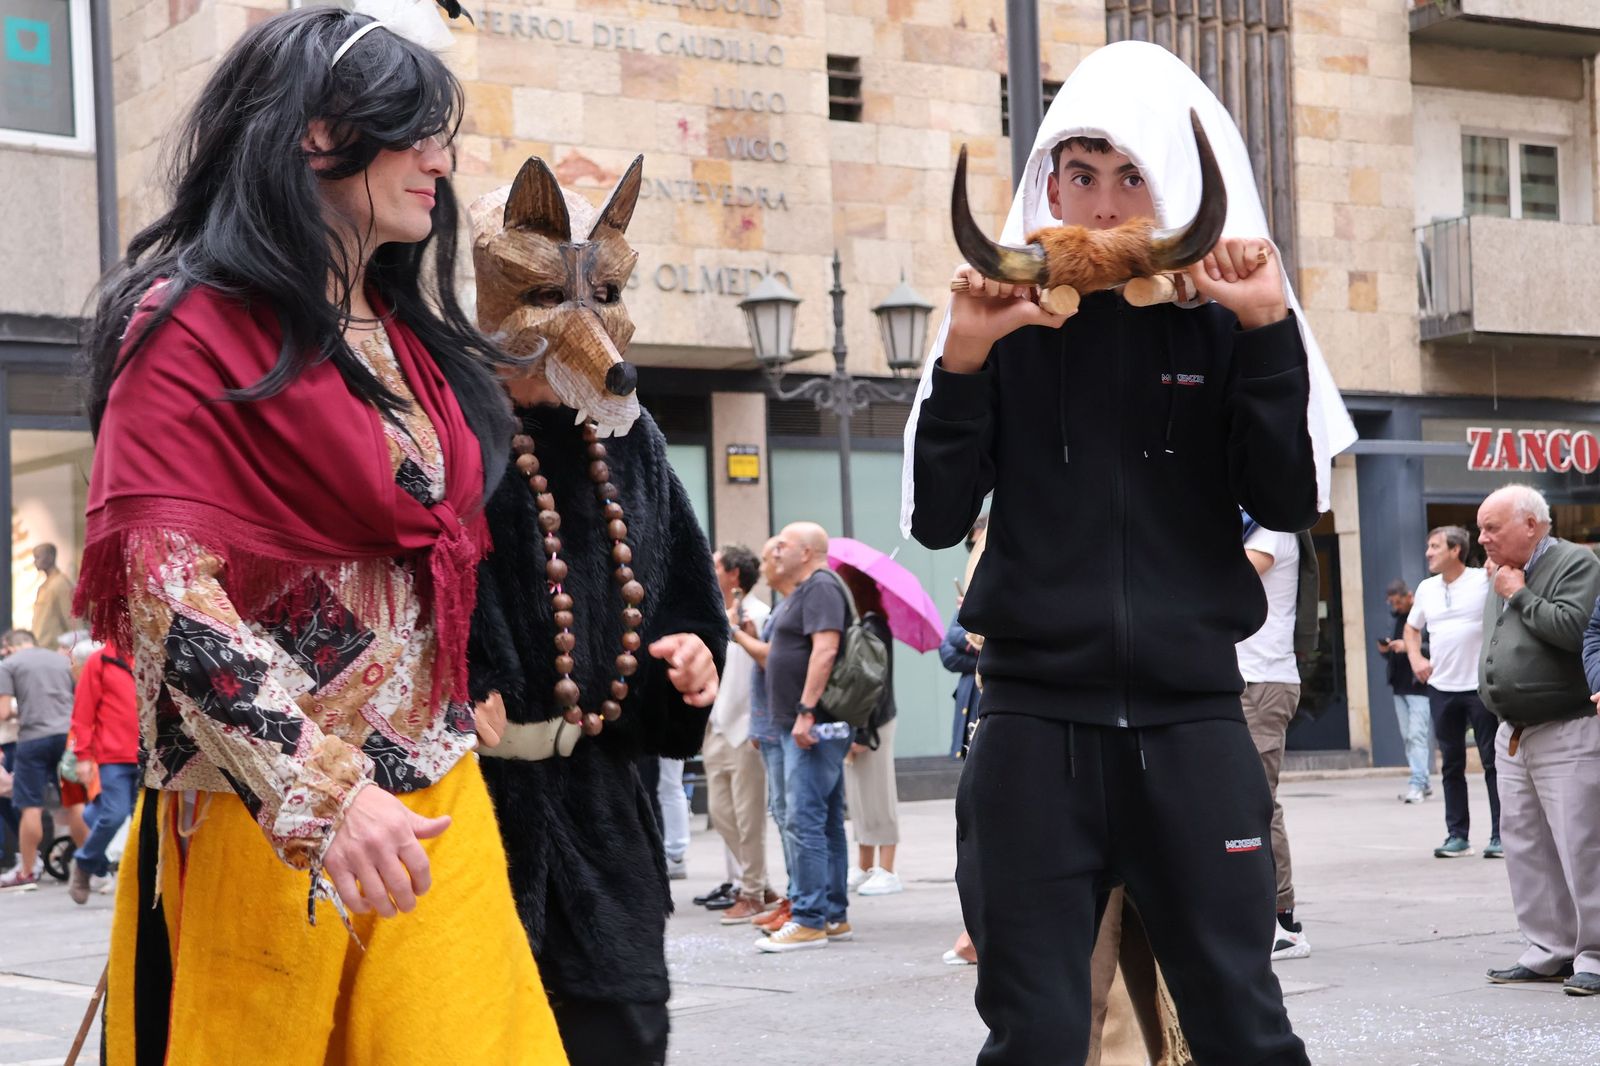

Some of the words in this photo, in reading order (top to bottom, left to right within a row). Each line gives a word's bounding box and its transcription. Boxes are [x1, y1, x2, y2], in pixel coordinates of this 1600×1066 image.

[476, 10, 583, 44] FERROL
[592, 22, 645, 52] DEL
[656, 32, 784, 67] CAUDILLO
[713, 87, 786, 115] LUGO
[723, 137, 789, 163] VIGO
[638, 177, 789, 212] ONTEVEDRA
[1466, 427, 1600, 474] ZANCO
